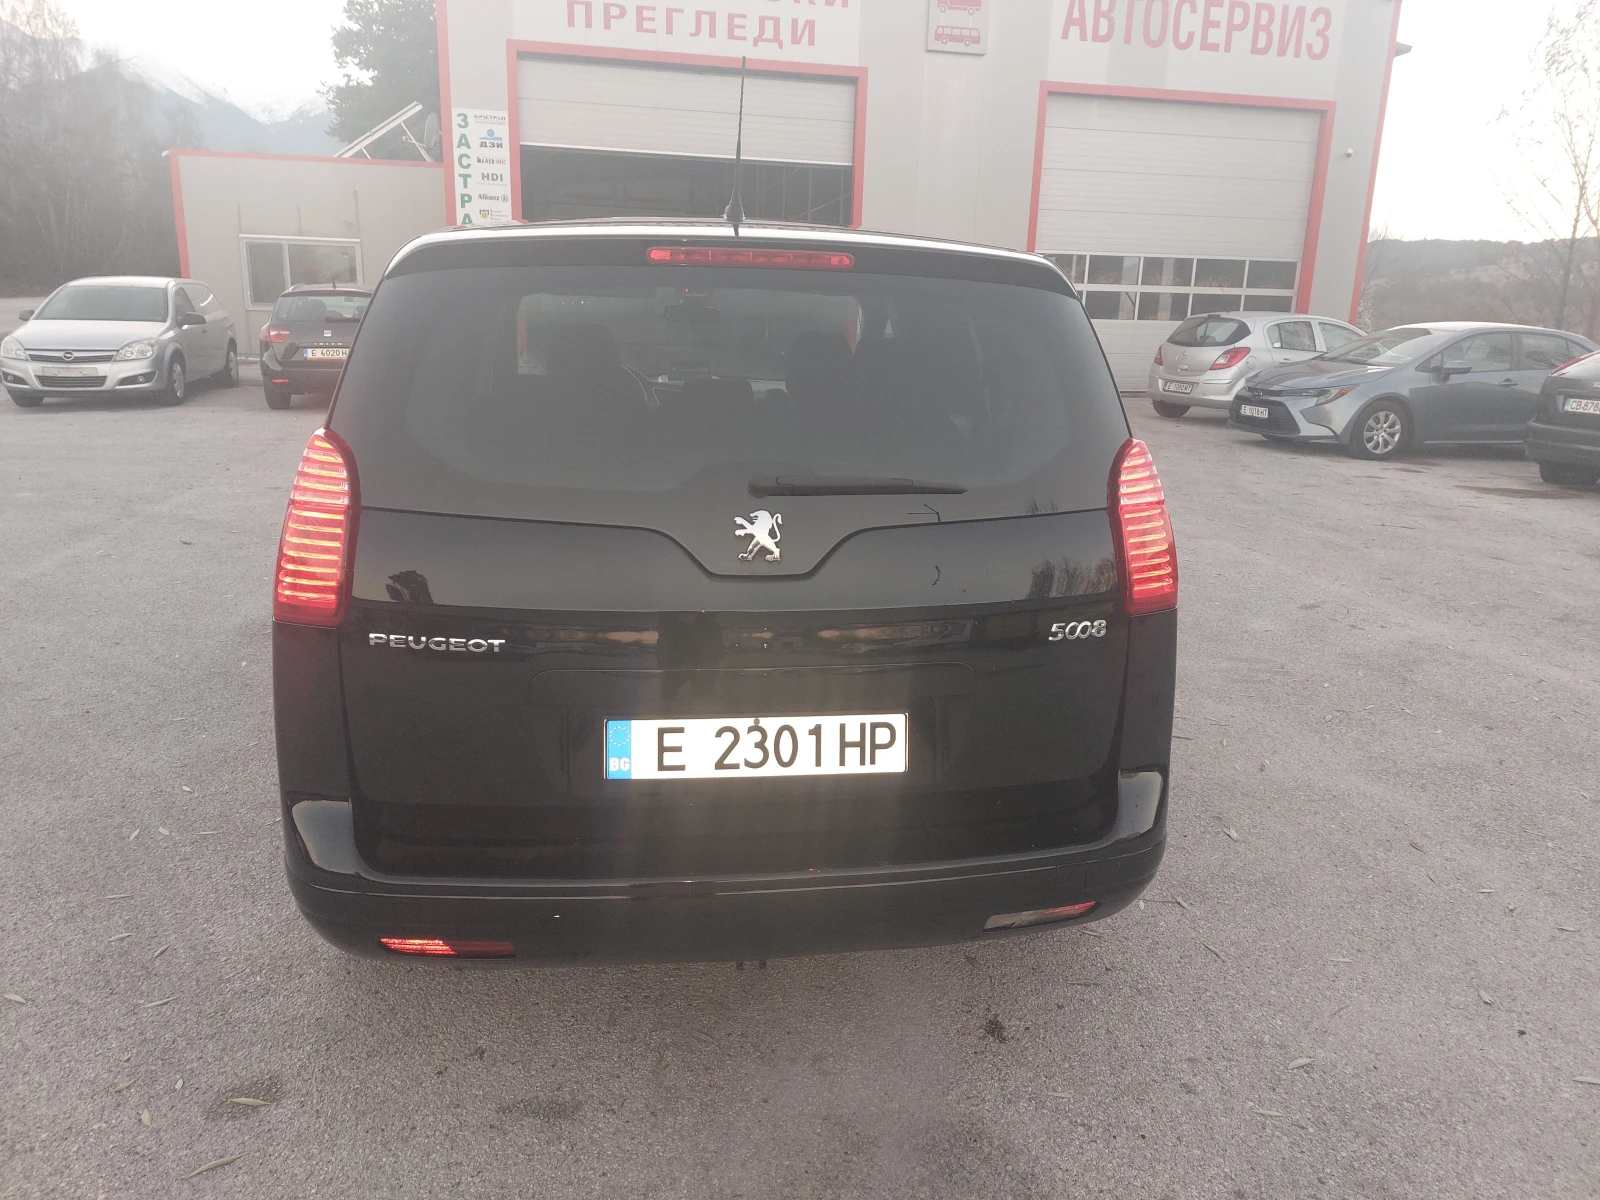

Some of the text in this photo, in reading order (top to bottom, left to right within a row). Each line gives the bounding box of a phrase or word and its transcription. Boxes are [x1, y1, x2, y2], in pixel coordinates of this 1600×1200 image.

[566, 0, 817, 49] ПРЕГЛЕДИ
[1061, 0, 1332, 61] АВТОСЕРВИЗ
[479, 141, 503, 149] ДЗИ
[481, 172, 504, 182] HDI
[477, 193, 500, 201] Allianz
[1048, 619, 1107, 641] 5008
[368, 632, 506, 653] PEUGEOT
[657, 726, 686, 771] E
[609, 757, 631, 772] BG
